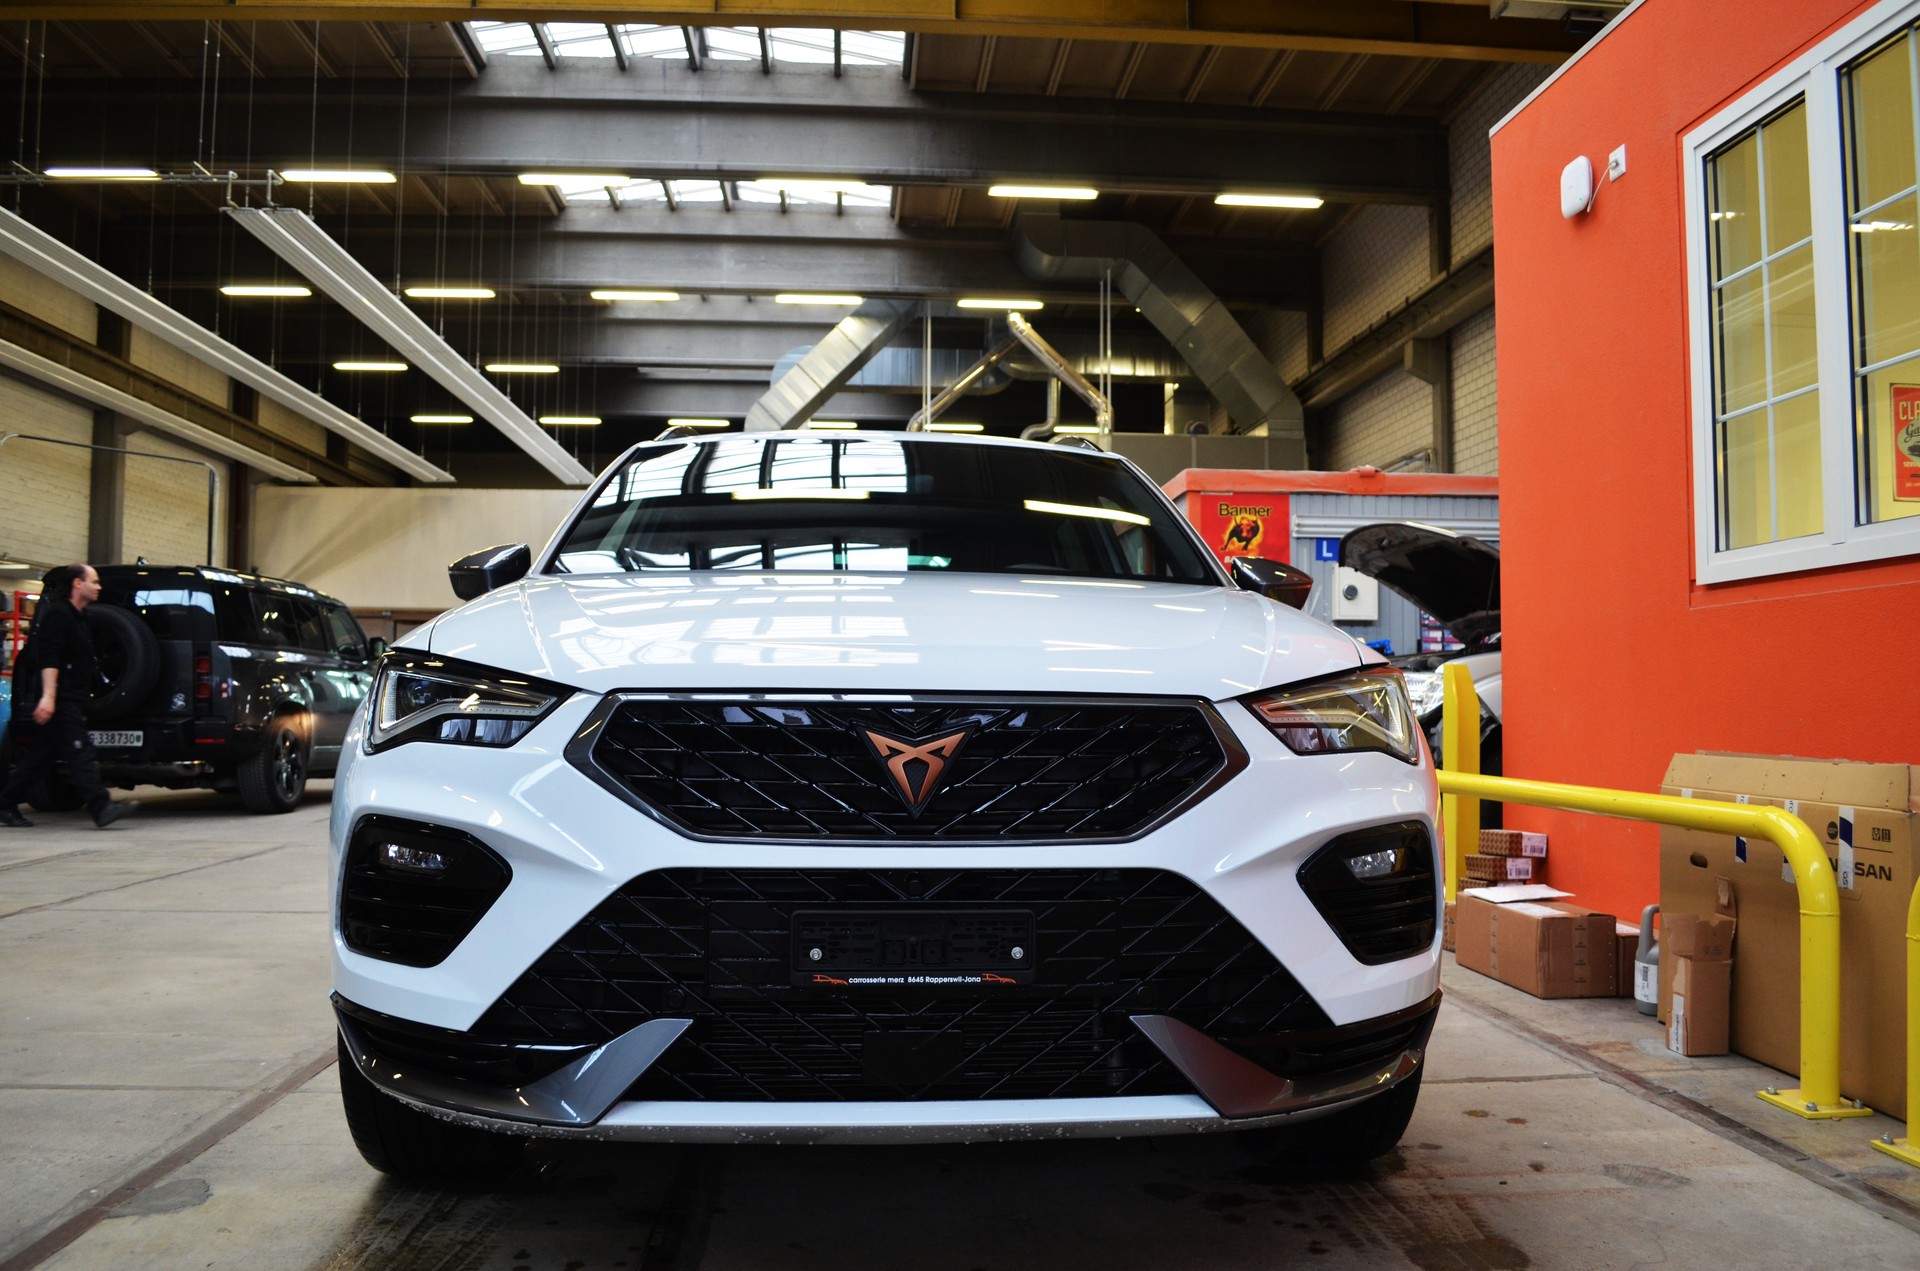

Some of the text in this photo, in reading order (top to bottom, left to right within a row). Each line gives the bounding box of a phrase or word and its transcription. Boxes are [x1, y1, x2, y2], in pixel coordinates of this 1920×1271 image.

[1218, 503, 1273, 517] Banner
[1321, 540, 1333, 558] L
[1828, 857, 1892, 882] NSAN
[848, 976, 886, 984] carrosserie
[887, 976, 905, 984] merz
[907, 976, 924, 984] 8645
